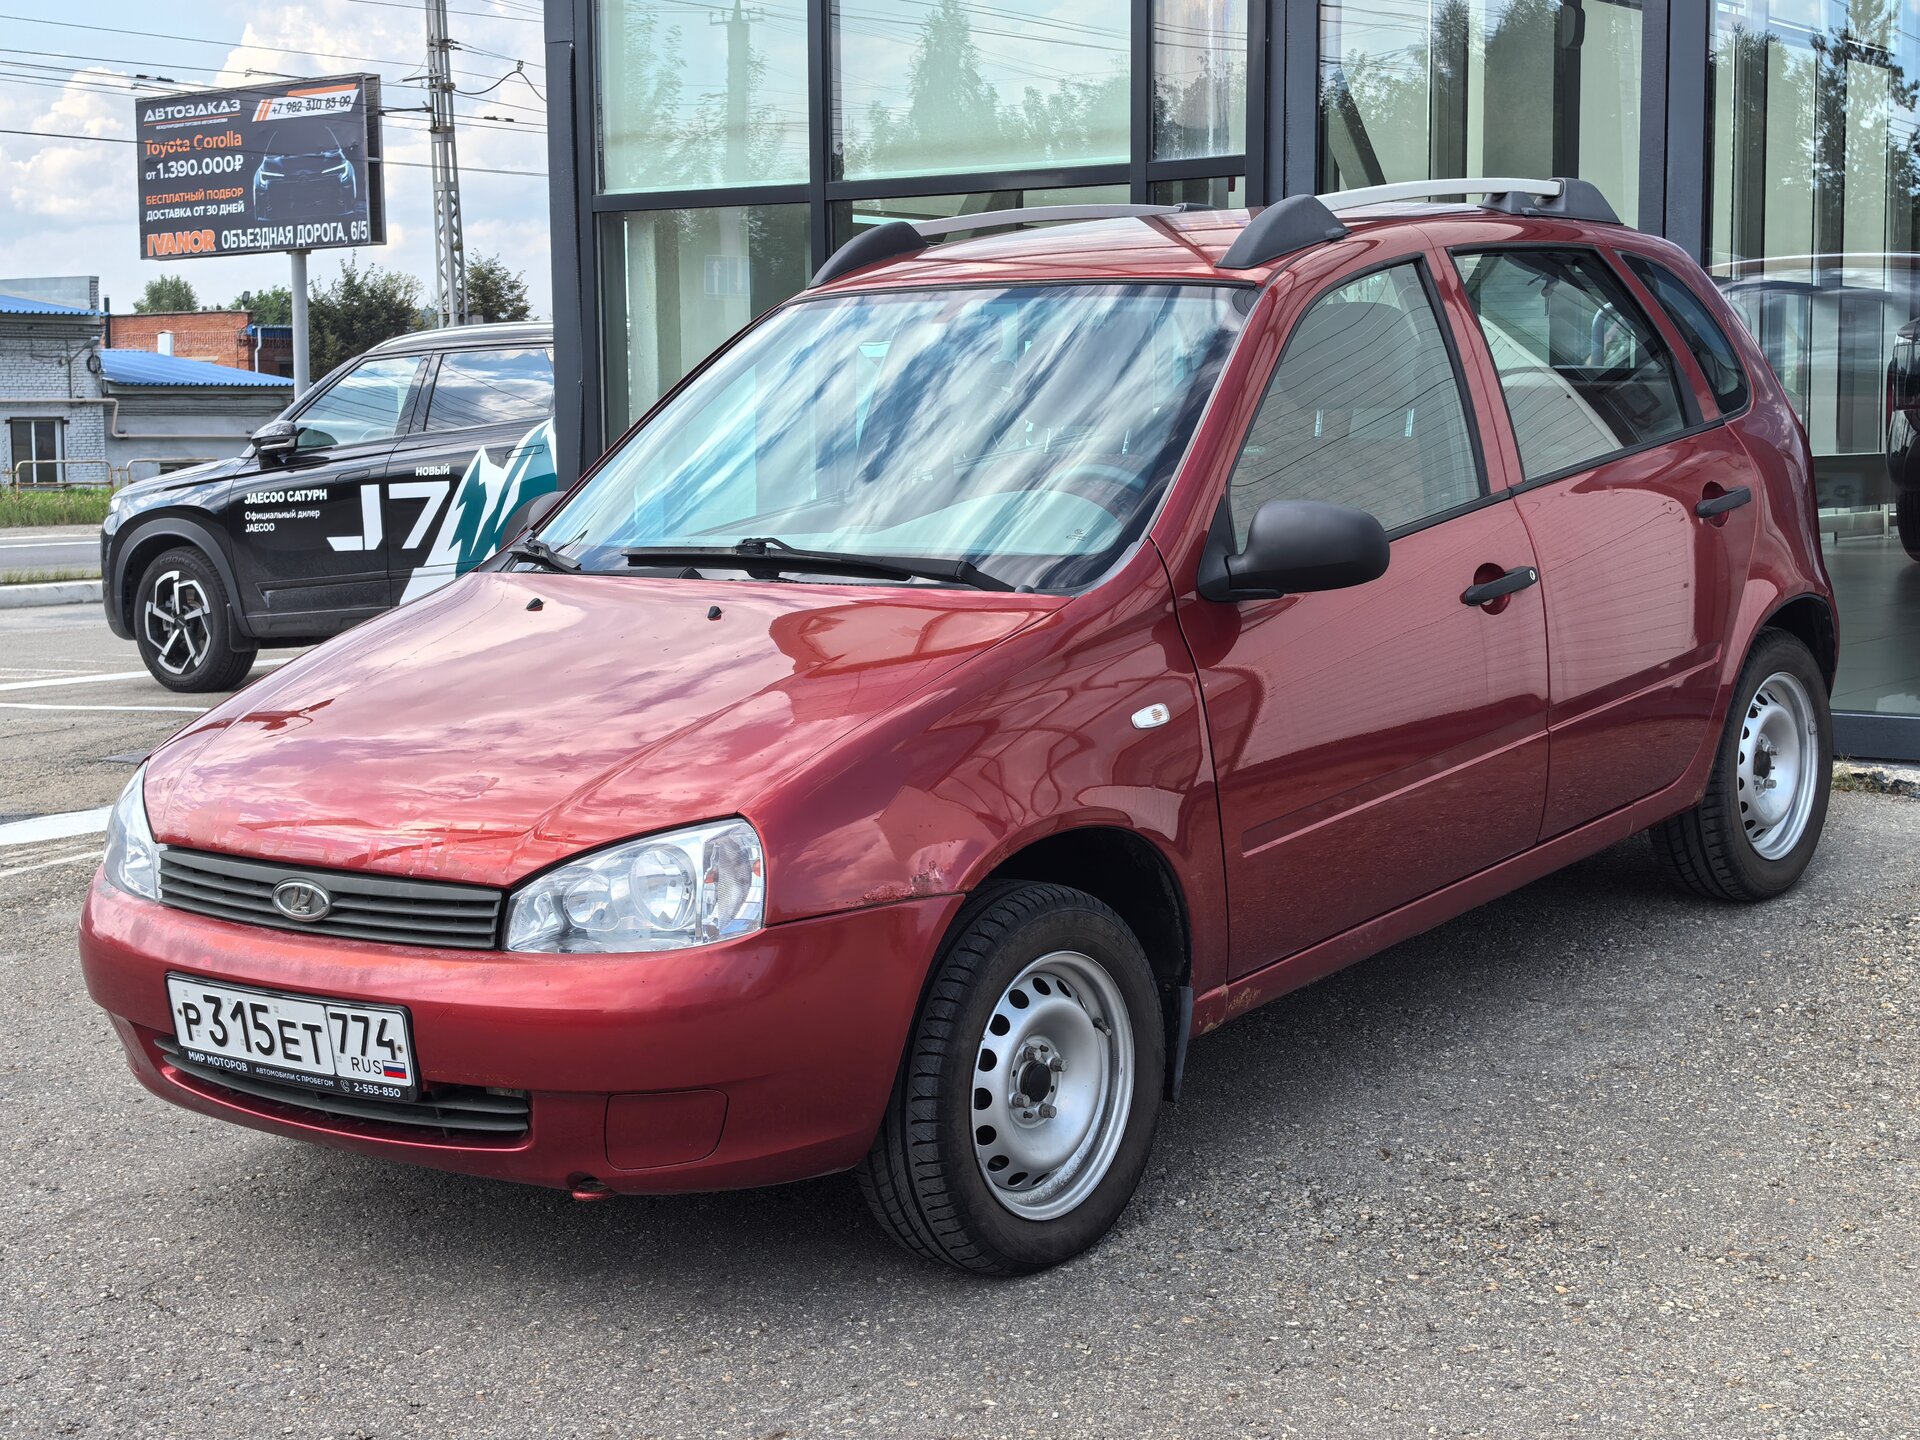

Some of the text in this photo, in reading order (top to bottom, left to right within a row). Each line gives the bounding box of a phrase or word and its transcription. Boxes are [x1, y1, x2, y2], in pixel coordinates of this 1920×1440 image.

[144, 100, 240, 122] АВТОЗАКАЗ
[272, 95, 352, 115] +7 982 310 83 09
[146, 131, 242, 158] Toyota Corolla
[146, 155, 244, 180] от 1.390.000₽
[146, 187, 244, 205] БЕСПЛАТНЫЙ ПОДБОР
[146, 200, 245, 222] ДОСТАВКА ОТ 30 ДНЕЙ
[146, 229, 217, 257] IVANOR
[222, 220, 367, 250] ОБЪЕЗДНАЯ ДОРОГА, 6/5
[416, 464, 450, 477] НОВЫЙ
[244, 488, 327, 505] JAECOO САТУРН
[245, 509, 320, 521] Официальный дилер
[326, 480, 450, 552] J7
[245, 522, 275, 533] JAECOO
[330, 1012, 396, 1061] 774
[188, 1051, 248, 1072] МИР МОТОРОВ
[350, 1057, 382, 1075] RUS
[256, 1067, 295, 1081] АВТОМОБИЛИ
[301, 1075, 334, 1088] ПРОБЕГОМ
[354, 1082, 401, 1098] 2-555-850
